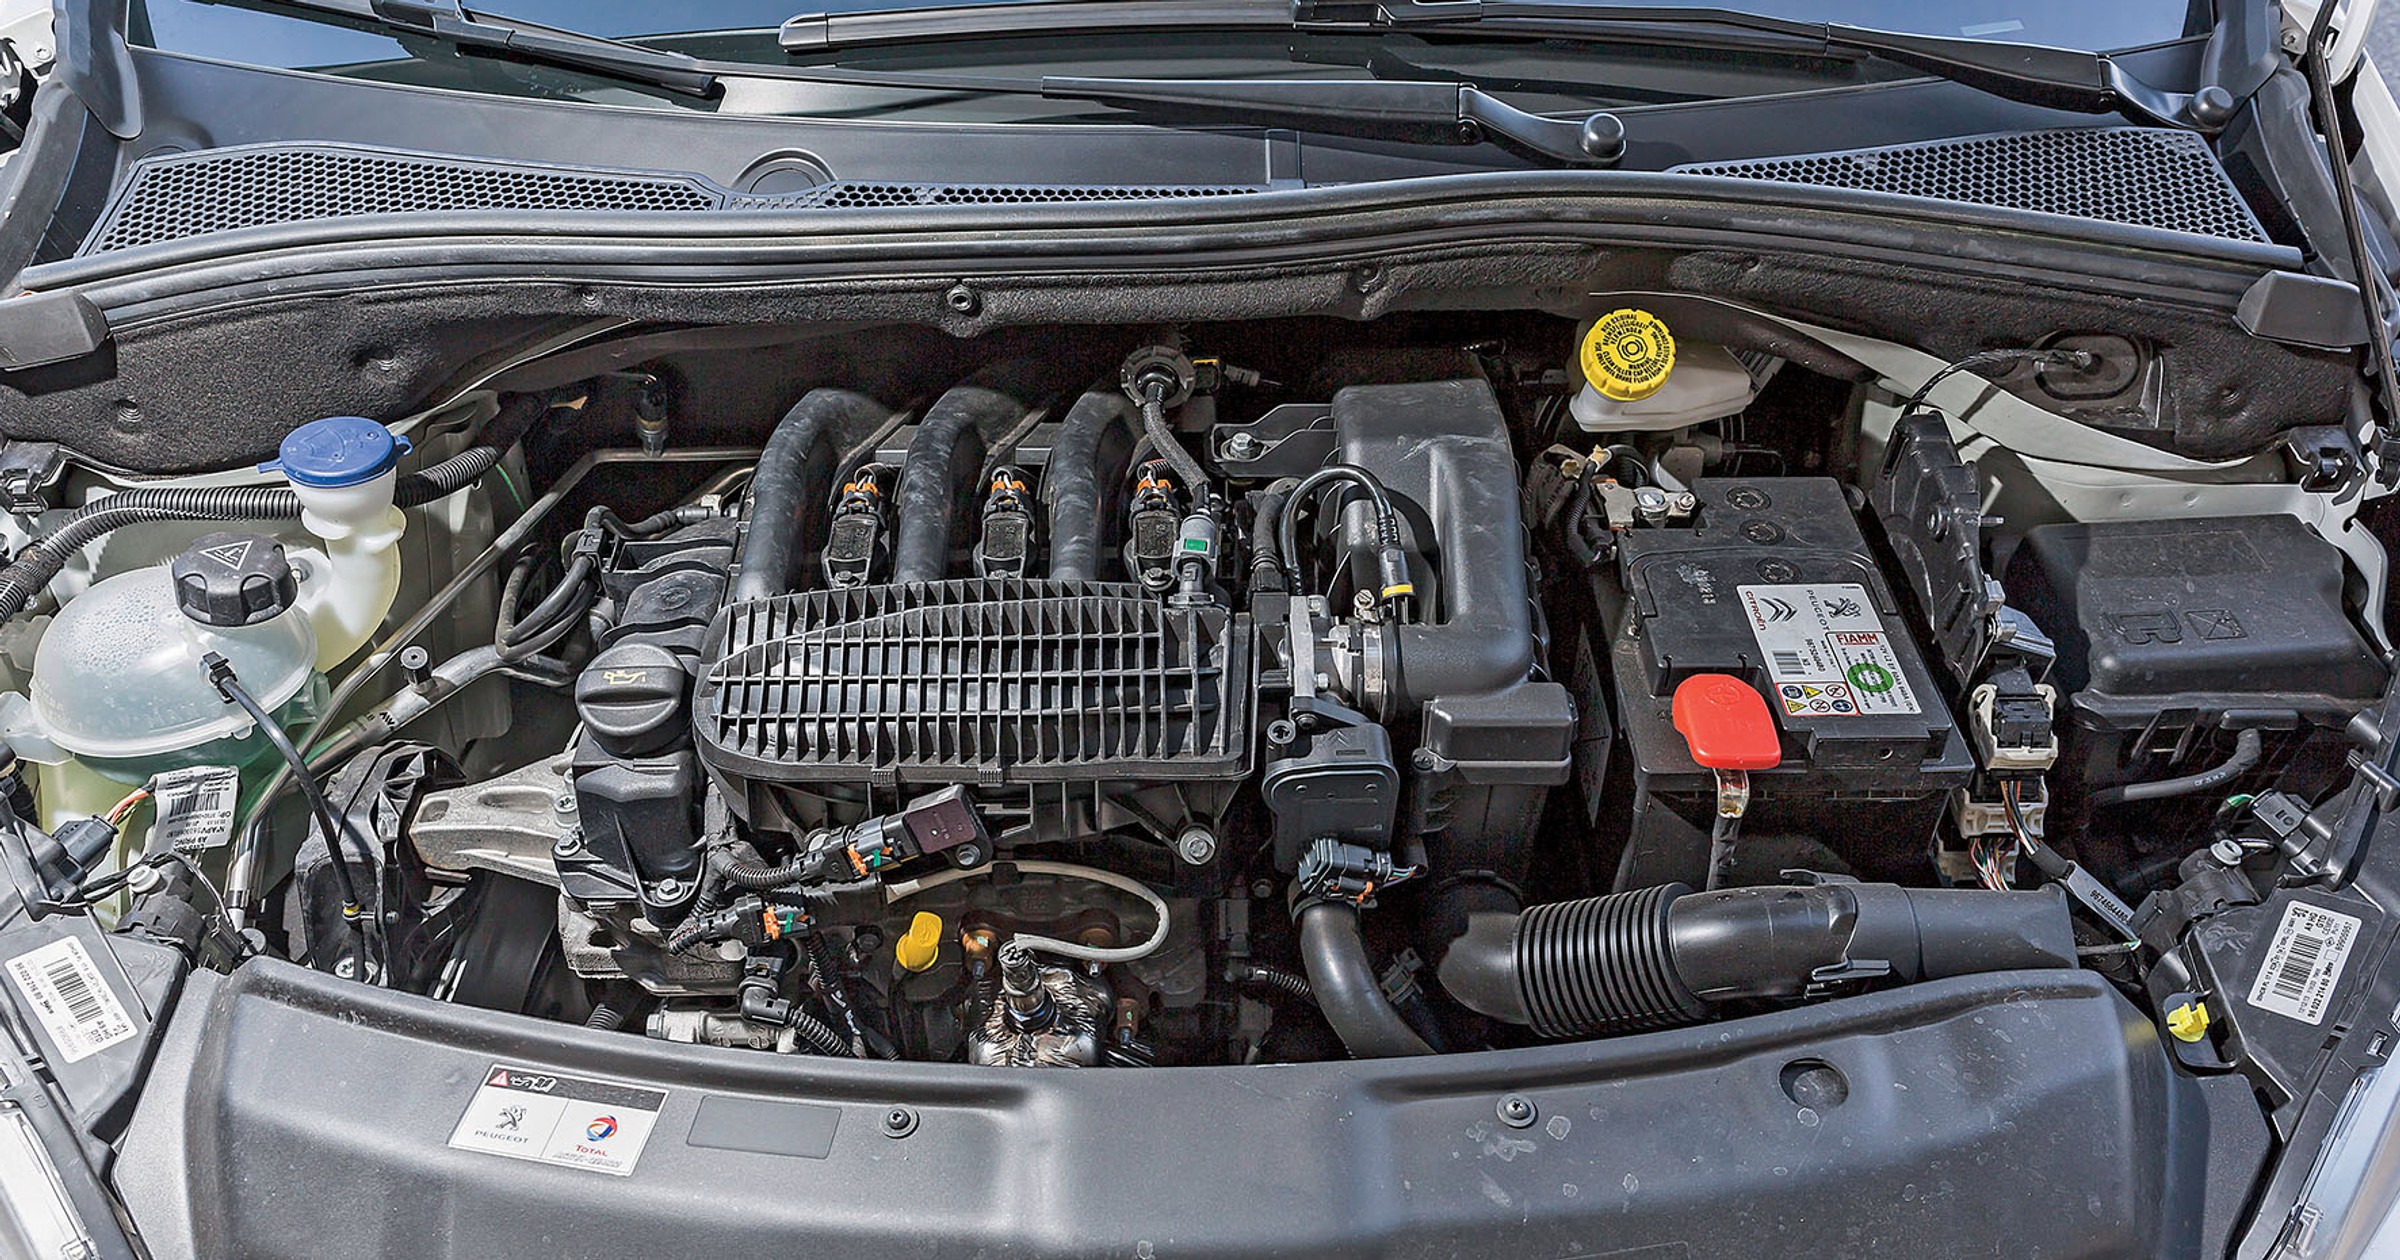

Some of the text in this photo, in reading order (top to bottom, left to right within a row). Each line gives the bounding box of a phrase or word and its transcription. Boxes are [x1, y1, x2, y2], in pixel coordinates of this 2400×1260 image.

[1806, 589, 1830, 631] PEUGEOT
[1836, 633, 1879, 645] FIAMM
[474, 1130, 529, 1144] PEUGEOT
[576, 1144, 608, 1157] TOTAL
